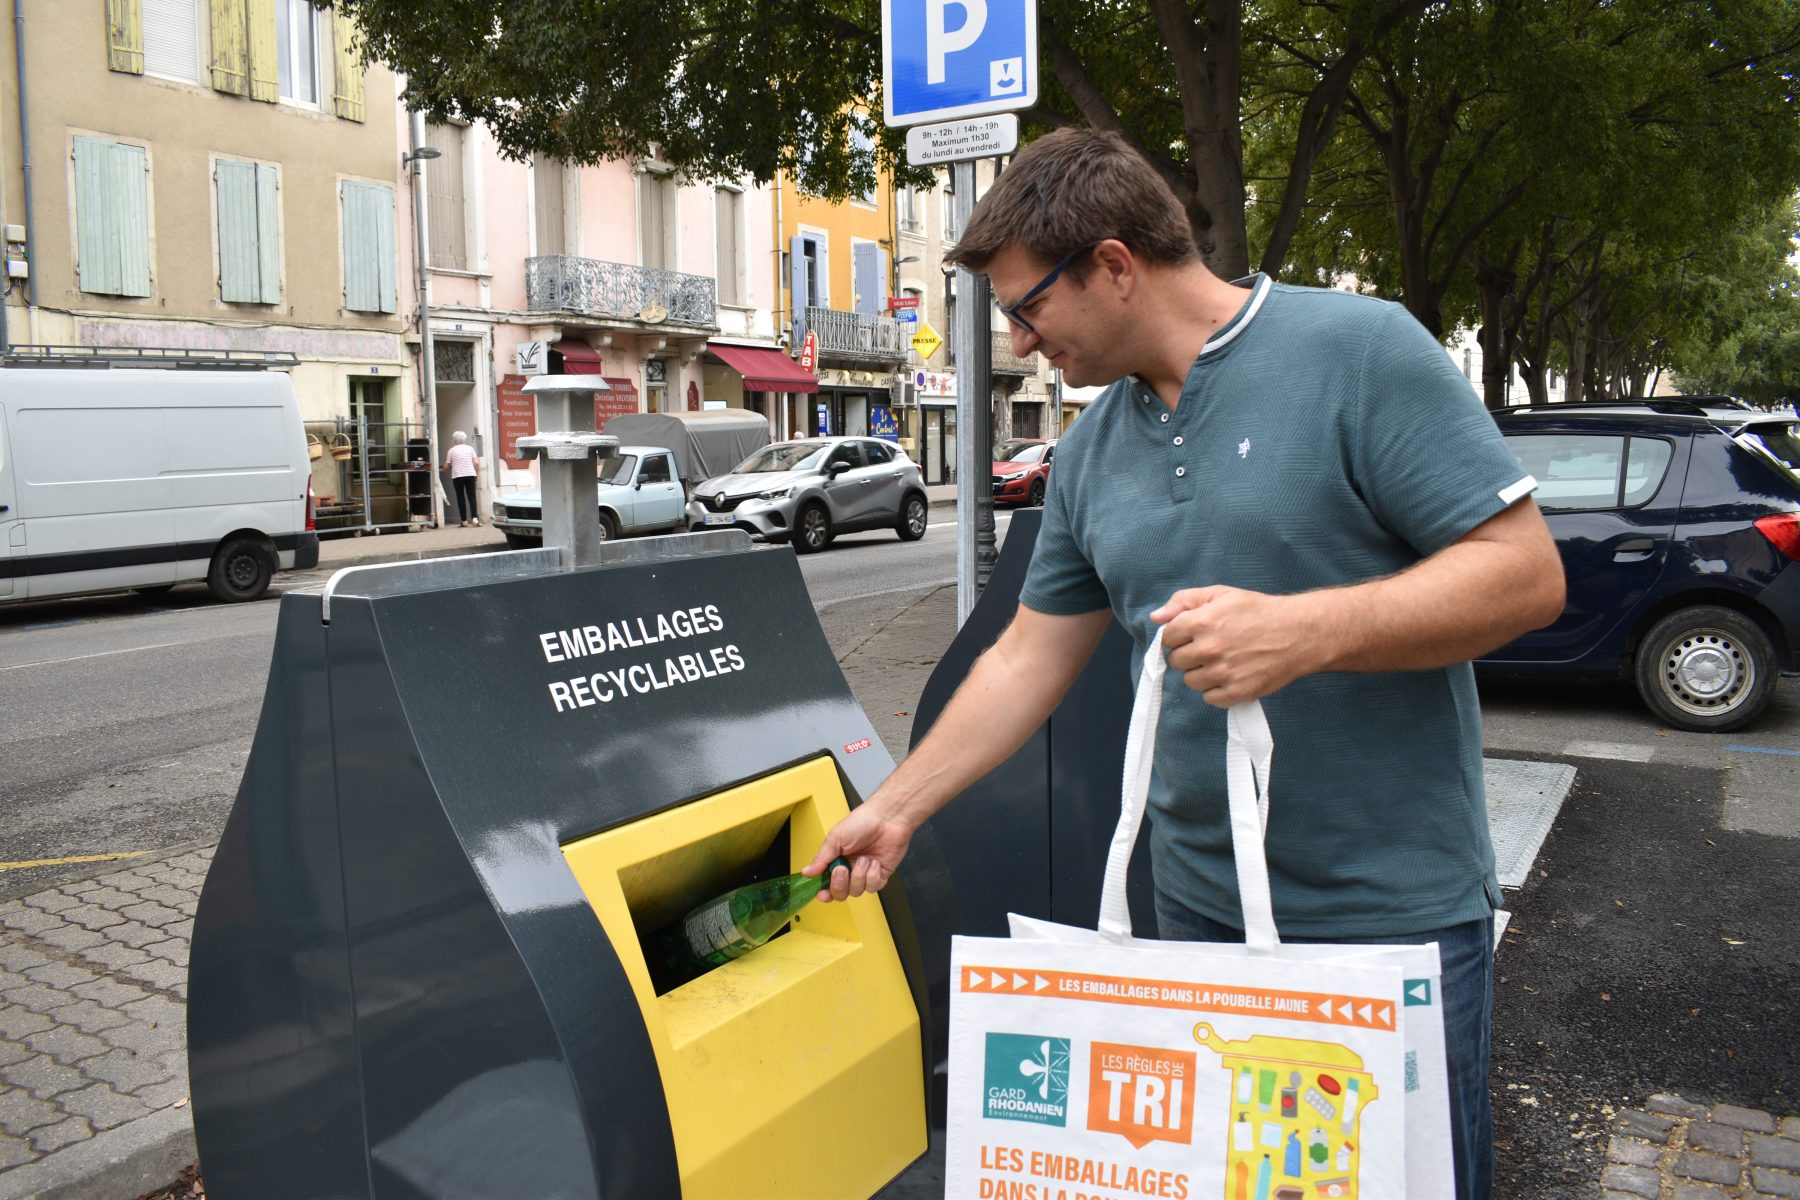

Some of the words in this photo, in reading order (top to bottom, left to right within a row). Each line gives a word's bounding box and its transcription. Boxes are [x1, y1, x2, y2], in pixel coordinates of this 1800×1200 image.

[926, 0, 988, 85] P
[922, 131, 932, 139] 9h
[939, 128, 953, 137] 12h
[964, 124, 978, 133] 14h
[985, 121, 999, 130] 19h
[932, 137, 969, 148] Maximum
[971, 132, 990, 142] 1h30
[921, 151, 932, 159] du
[933, 147, 953, 157] lundi
[966, 141, 1001, 153] vendredi
[801, 335, 813, 371] TAB
[539, 604, 724, 663] EMBALLAGES
[548, 644, 746, 713] RECYCLABLES
[1059, 978, 1081, 992] LES
[1082, 981, 1159, 1000] EMBALLAGES
[1161, 988, 1194, 1004] DANS
[1195, 990, 1212, 1005] LA
[1213, 992, 1273, 1011] POUBELLE
[1273, 997, 1309, 1014] JAUNE
[1102, 1054, 1123, 1069] LES
[1126, 1054, 1170, 1075] RÈGLES
[1172, 1062, 1185, 1077] DE
[988, 1087, 1026, 1100] GARD
[1102, 1070, 1184, 1130] TRI
[988, 1109, 1048, 1121] Environnement
[980, 1145, 1024, 1173] LES
[1030, 1150, 1189, 1200] EMBALLAGES
[979, 1178, 1037, 1200] DANS
